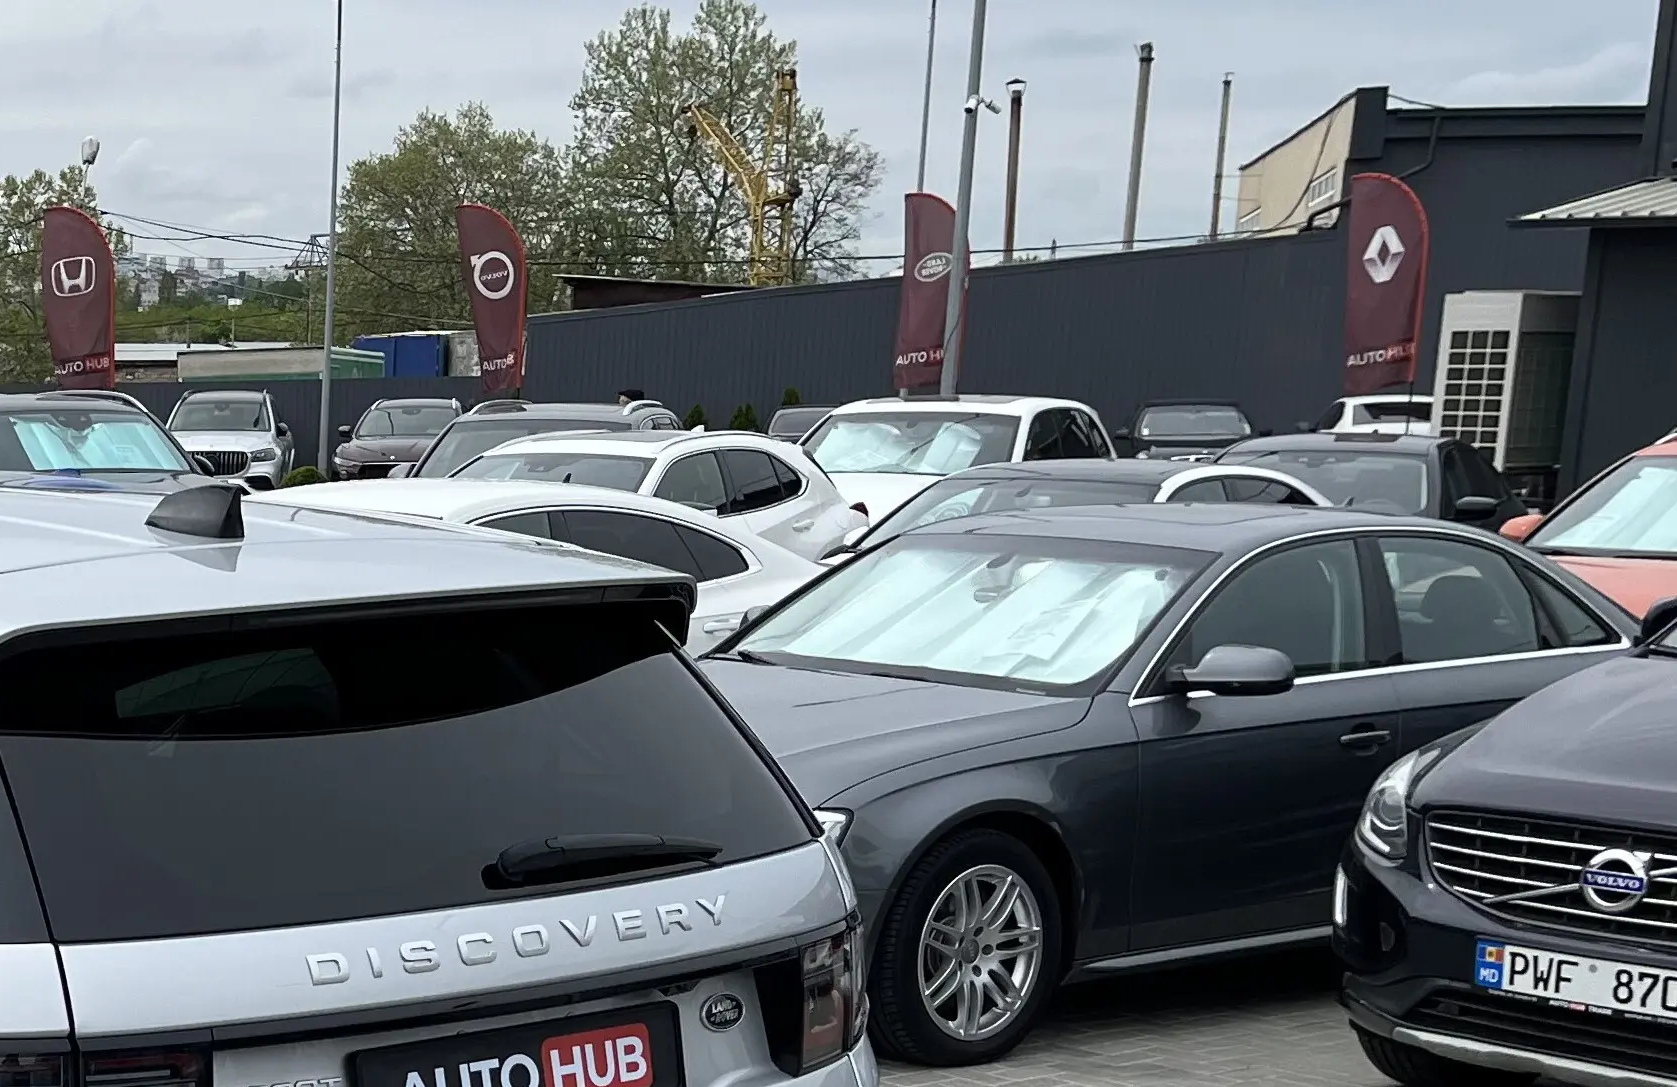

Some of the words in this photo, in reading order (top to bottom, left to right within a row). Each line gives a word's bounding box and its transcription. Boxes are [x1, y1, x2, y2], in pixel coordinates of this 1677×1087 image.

[54, 361, 84, 375] AUTO
[85, 357, 110, 371] HUB
[895, 351, 927, 366] AUTO
[1346, 350, 1386, 368] AUTO
[1586, 873, 1640, 889] VOLVO
[305, 894, 727, 986] DISCOVERY
[1479, 965, 1500, 983] MD
[1508, 951, 1580, 994] PWF
